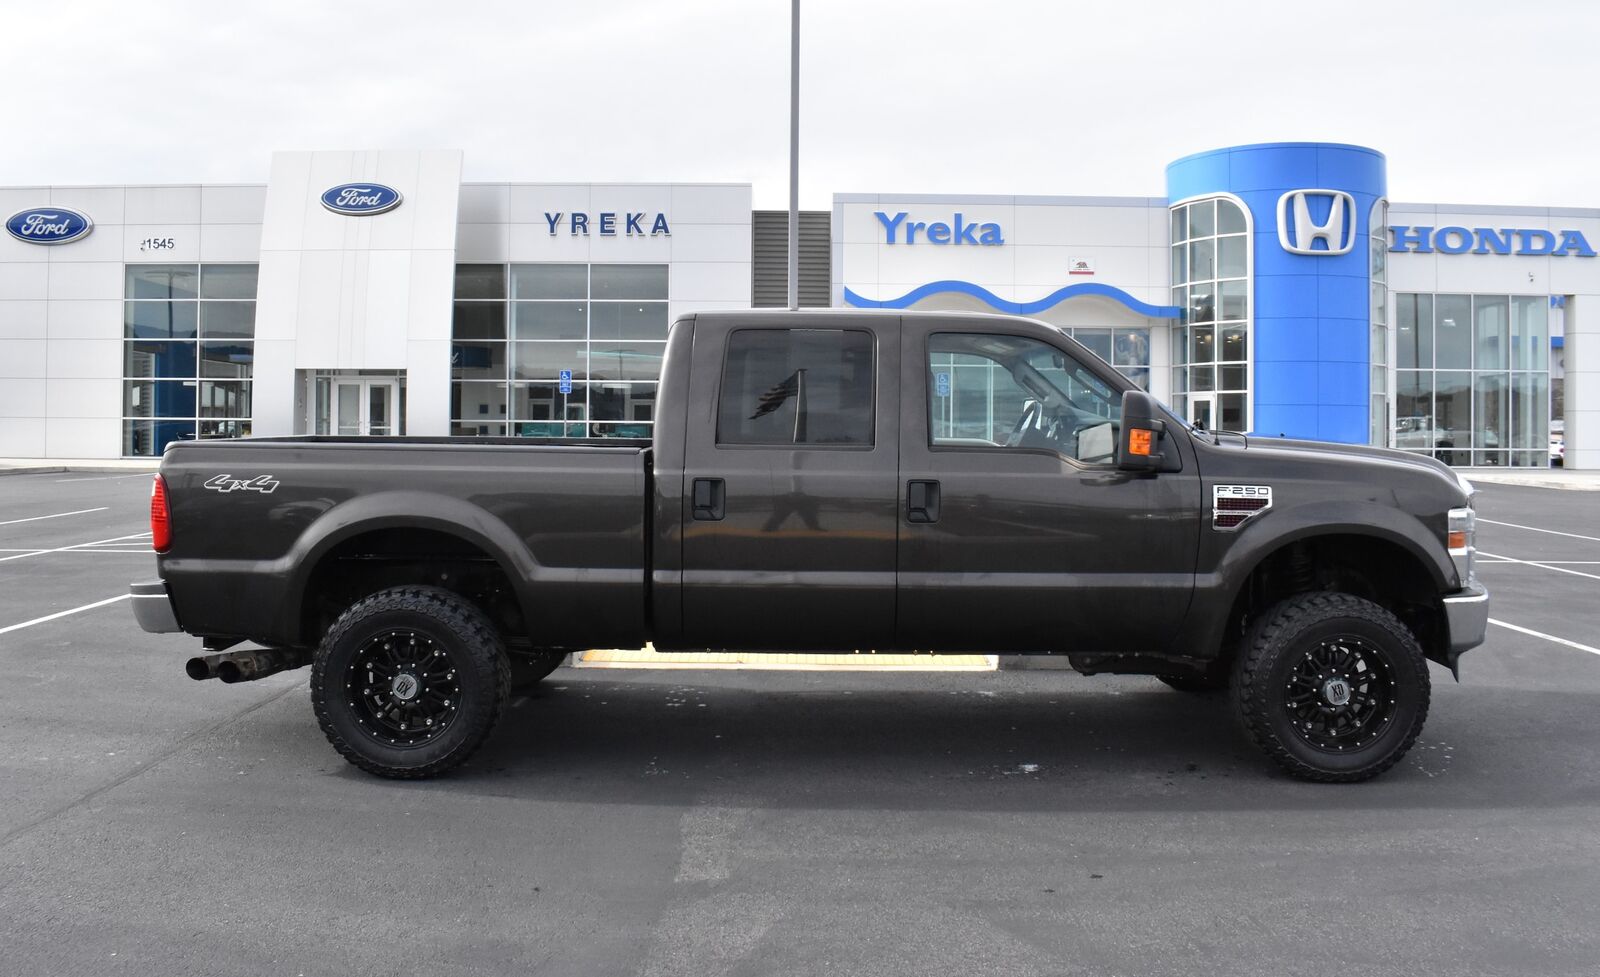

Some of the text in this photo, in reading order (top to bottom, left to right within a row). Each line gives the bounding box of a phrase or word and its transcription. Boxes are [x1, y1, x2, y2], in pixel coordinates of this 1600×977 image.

[336, 187, 382, 206] Ford
[21, 213, 70, 236] Ford
[544, 212, 672, 236] YREKA
[873, 211, 1006, 246] Yreka
[146, 238, 175, 250] 1545
[1388, 225, 1598, 257] HONDA
